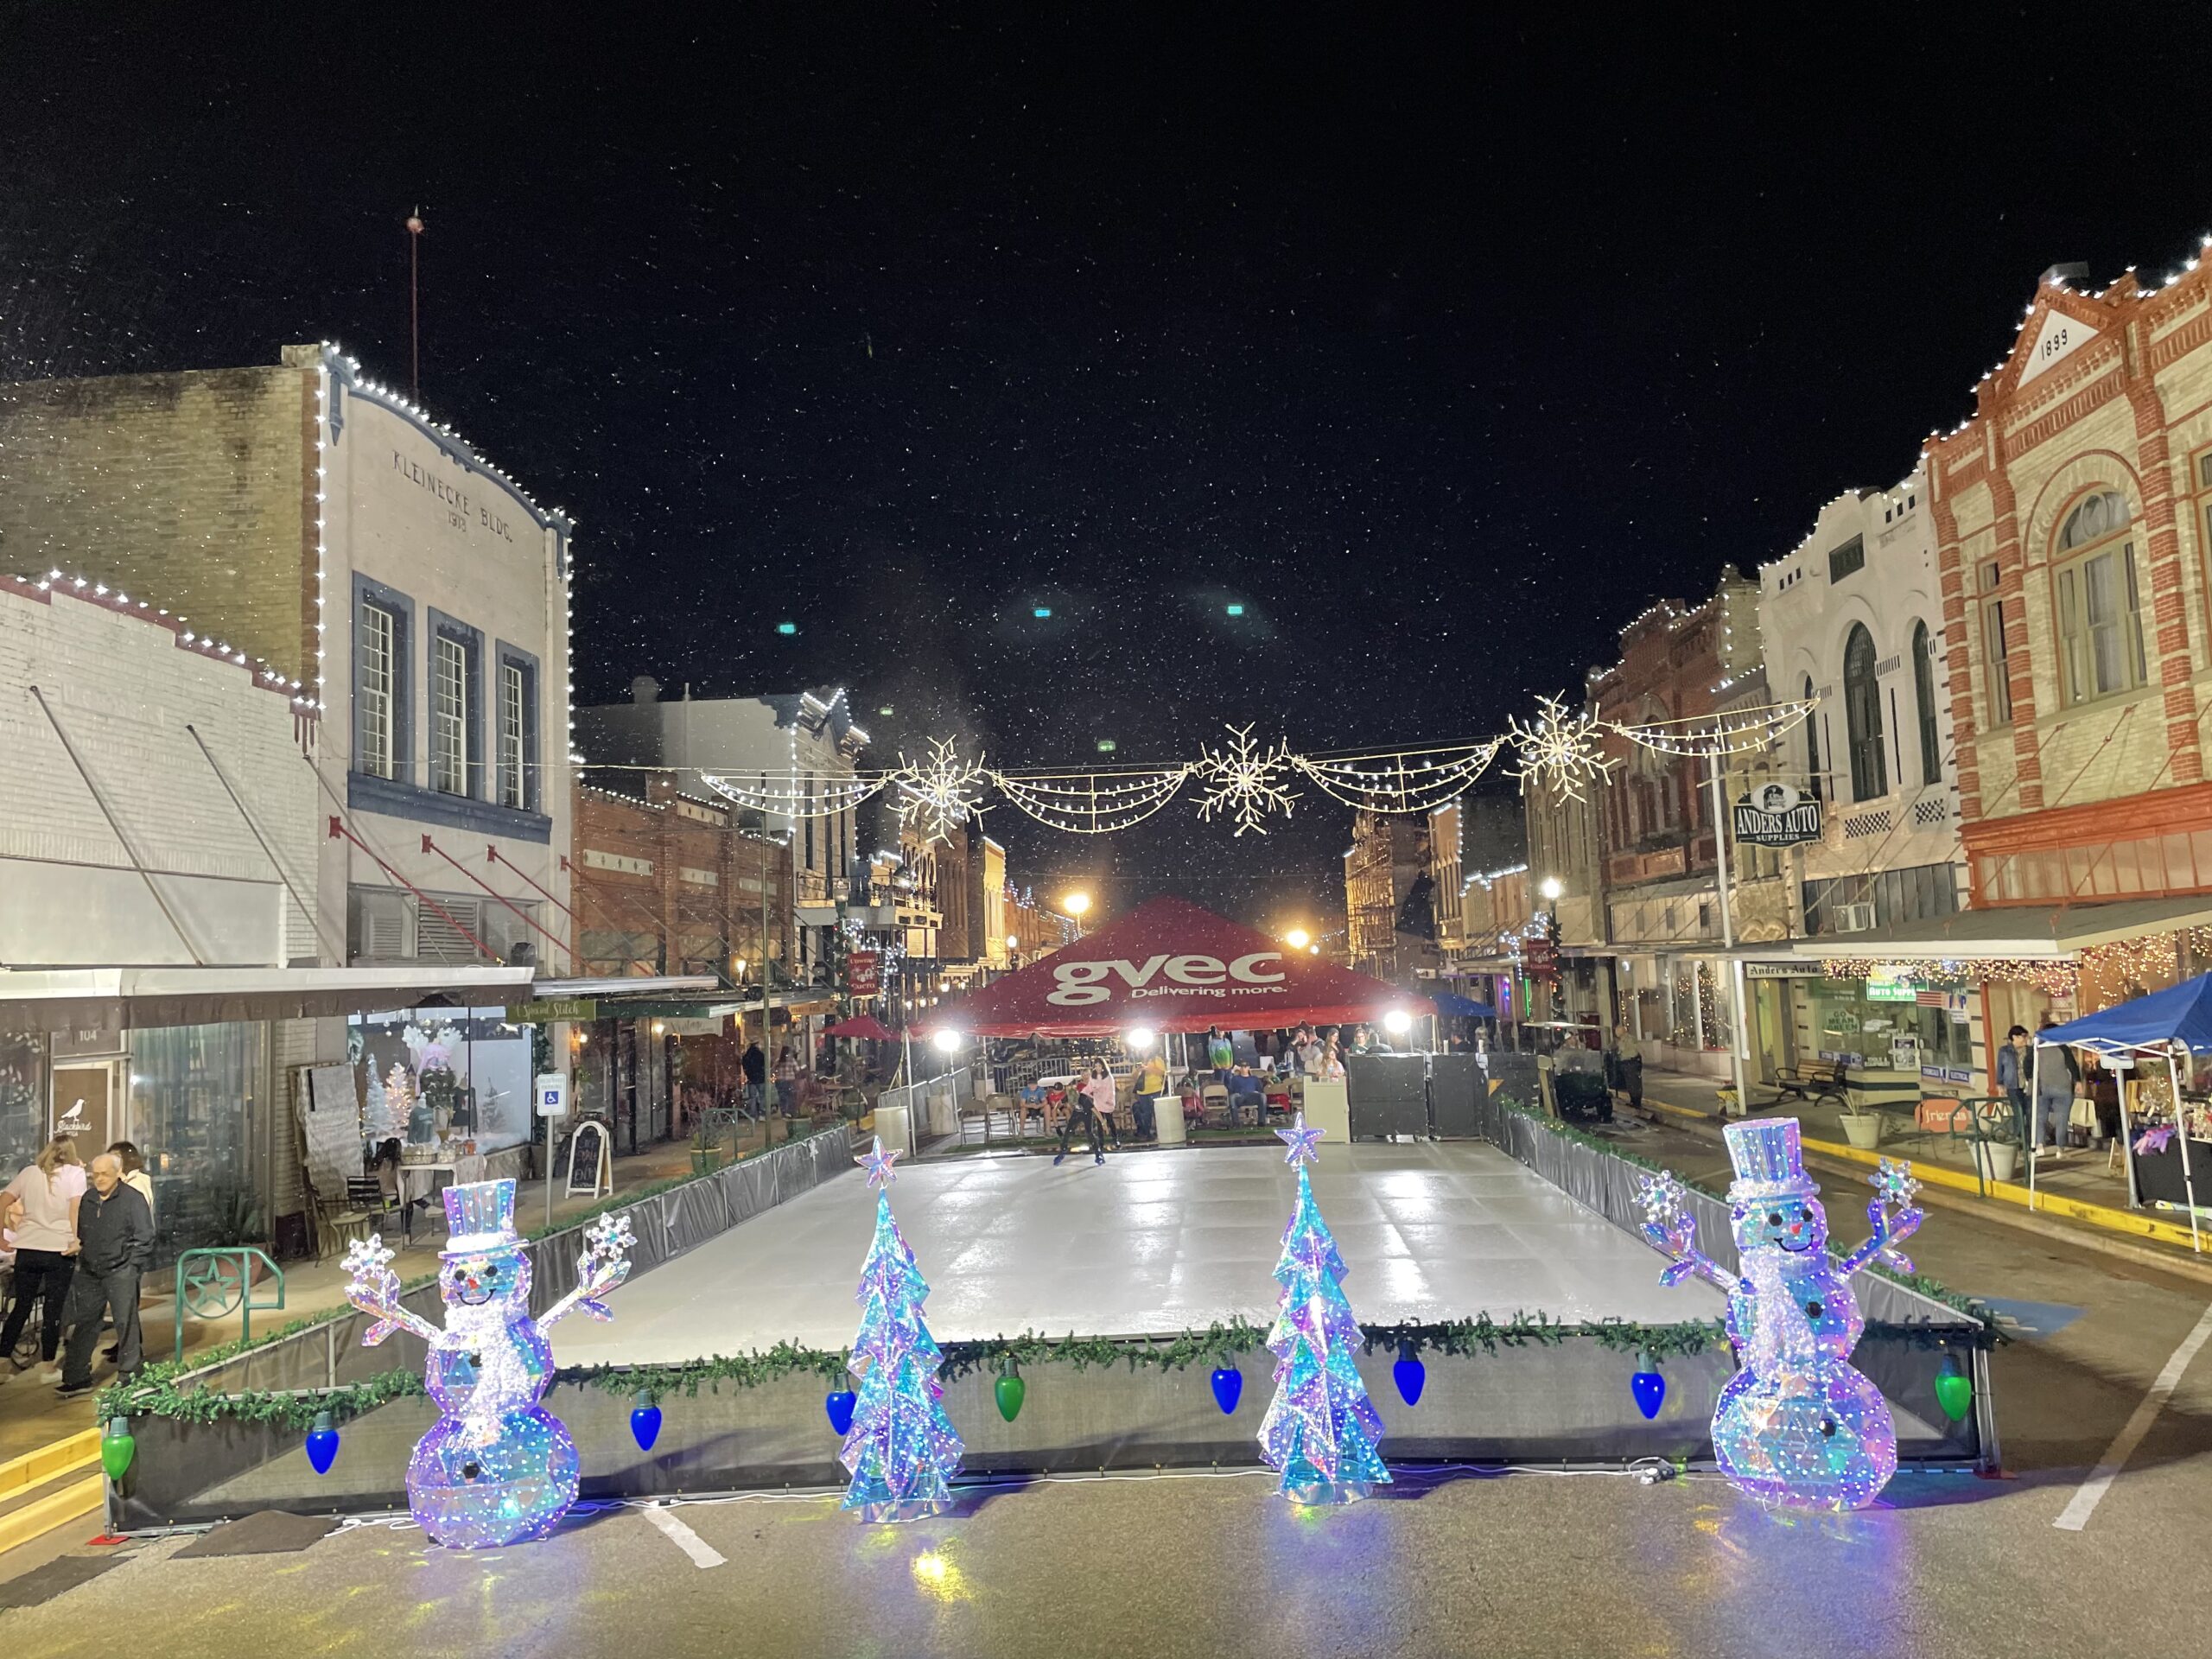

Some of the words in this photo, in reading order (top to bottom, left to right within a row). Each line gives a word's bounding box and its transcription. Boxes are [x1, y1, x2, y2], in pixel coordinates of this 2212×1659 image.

[2041, 328, 2068, 360] 1899
[392, 449, 470, 516] KLEINECKE
[480, 507, 512, 543] BLDG.
[1737, 808, 1783, 835] ANDERS
[1785, 804, 1818, 833] AUTO
[1756, 833, 1800, 842] SUPPLIES
[1046, 952, 1286, 1006] gvec
[1750, 966, 1788, 976] Anders
[1131, 986, 1226, 999] Delivering
[1231, 986, 1287, 995] more.
[79, 1030, 97, 1041] 104
